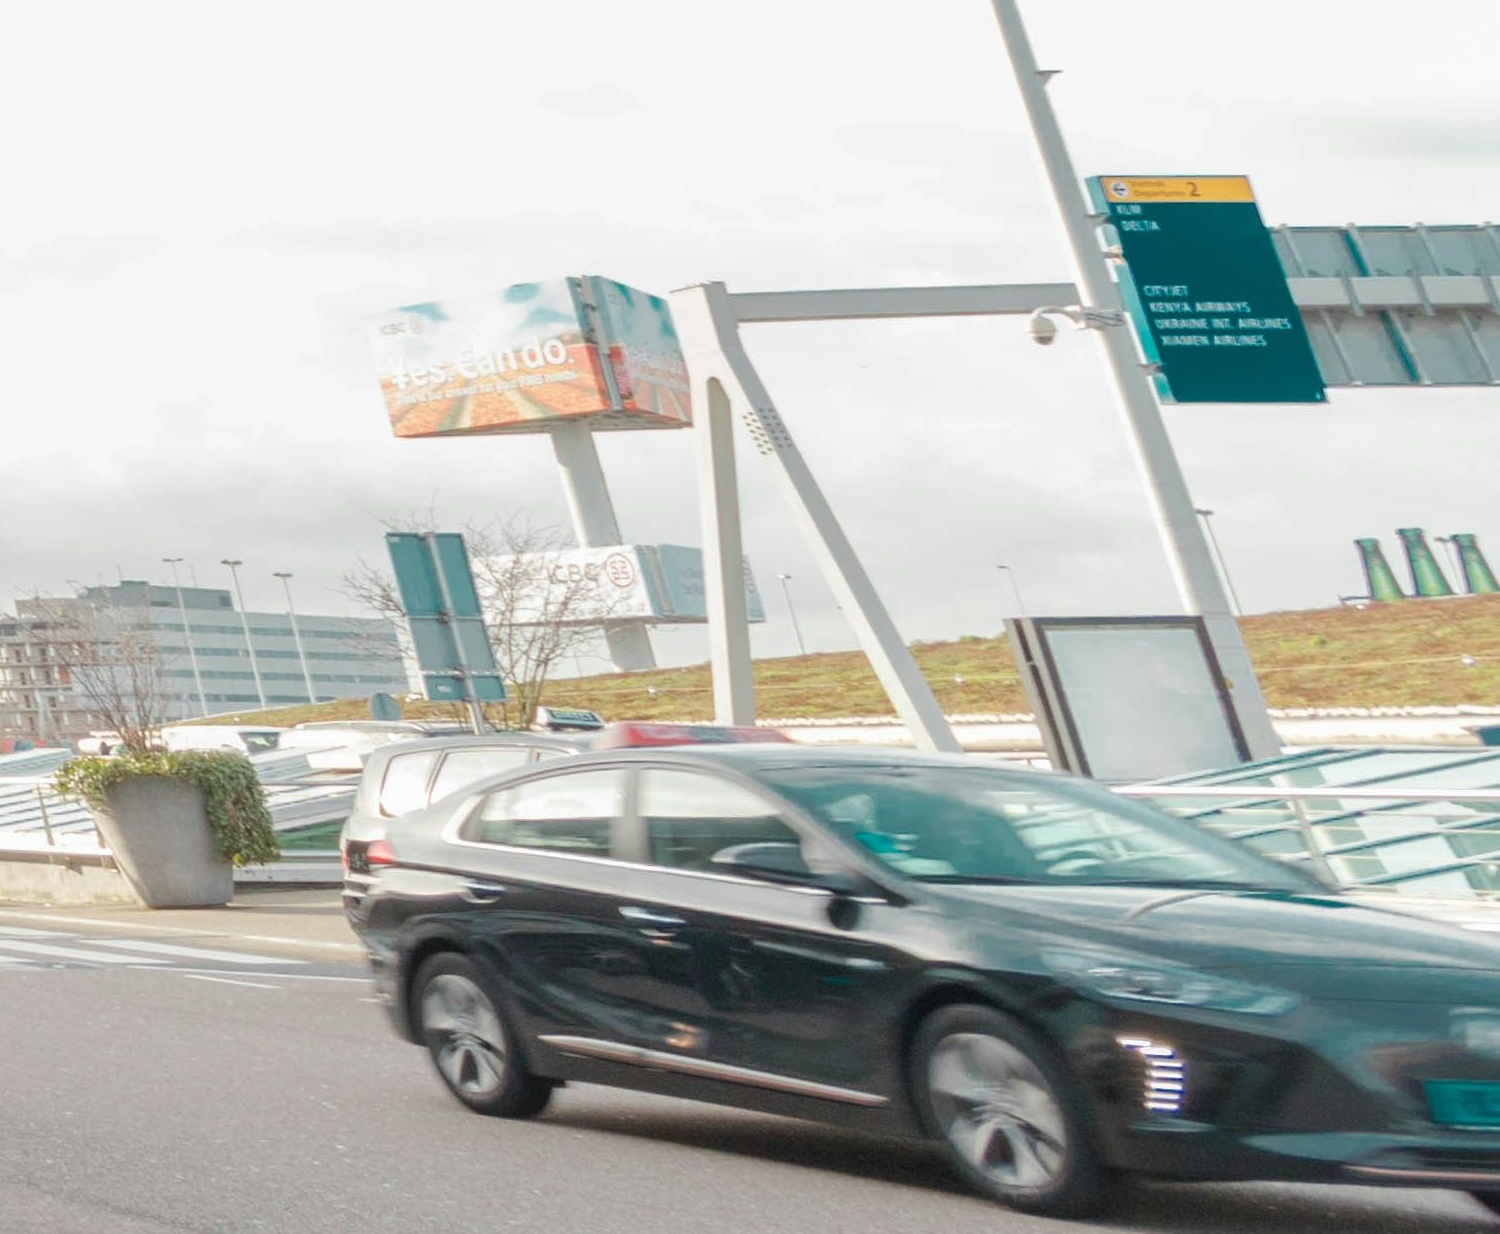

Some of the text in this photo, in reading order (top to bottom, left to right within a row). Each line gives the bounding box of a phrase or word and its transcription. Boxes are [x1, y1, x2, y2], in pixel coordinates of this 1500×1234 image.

[1187, 182, 1201, 197] 2
[1121, 220, 1161, 231] DELTA
[1150, 302, 1251, 313] KENYA AIRWAYS
[1155, 318, 1209, 330] UKRAINE
[1238, 318, 1292, 330] AIRLINES
[1213, 335, 1267, 347] AIRLINES
